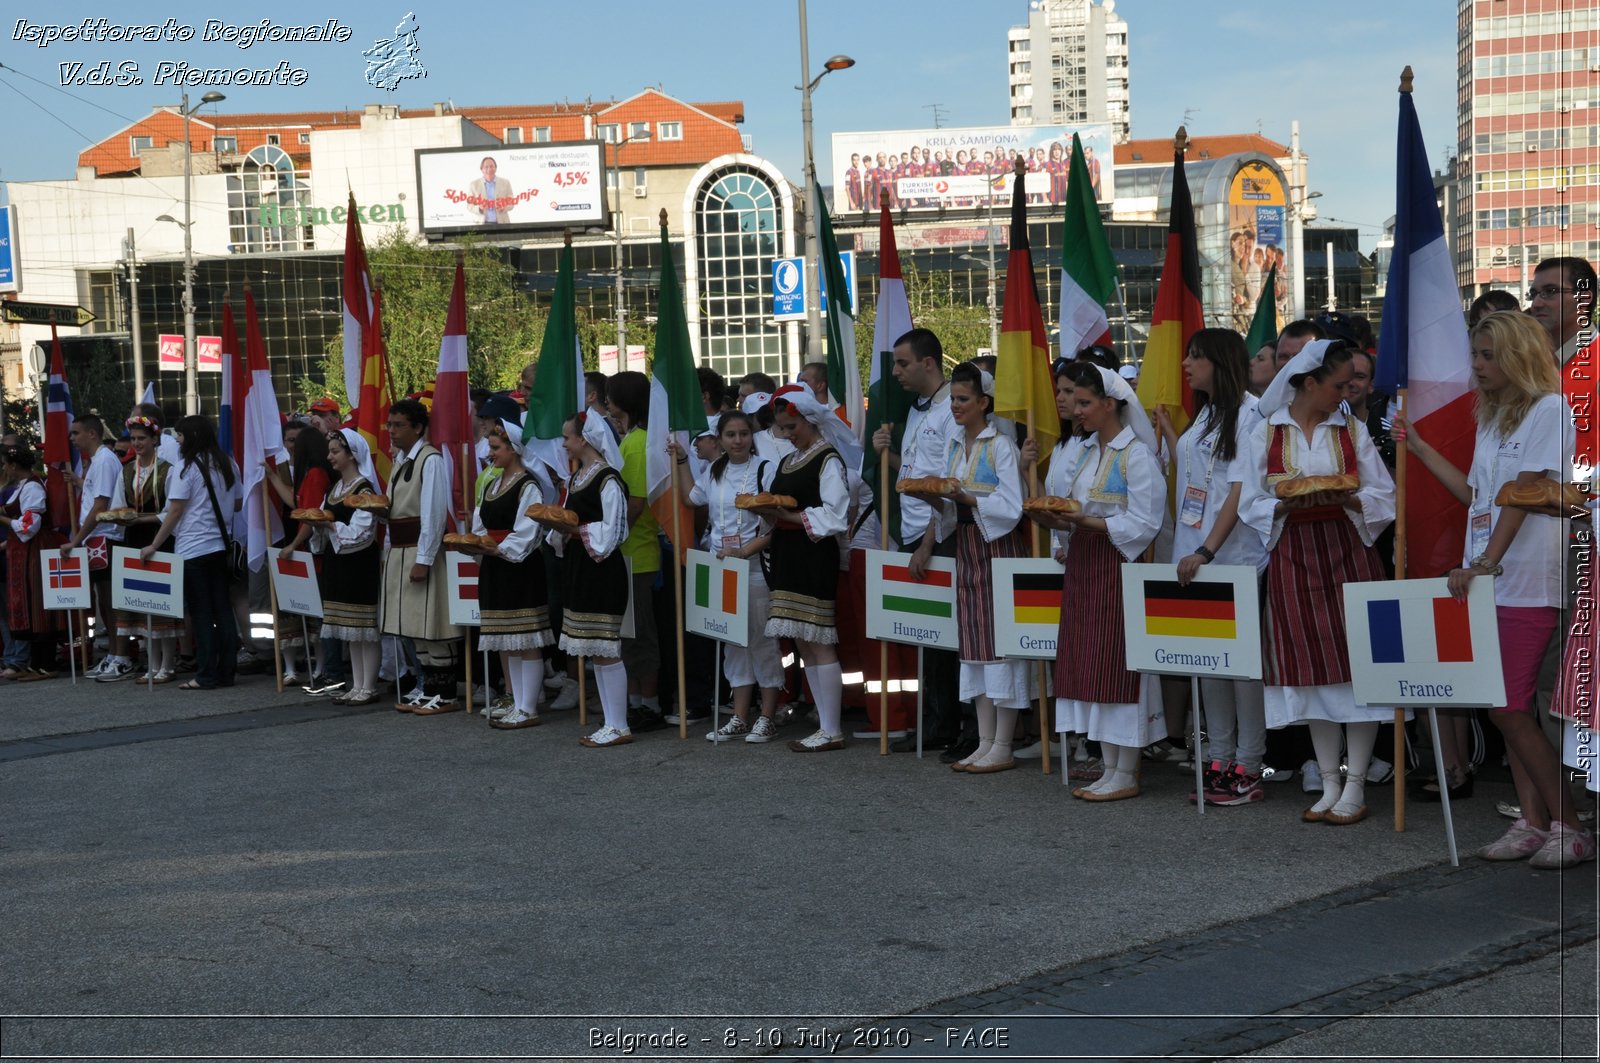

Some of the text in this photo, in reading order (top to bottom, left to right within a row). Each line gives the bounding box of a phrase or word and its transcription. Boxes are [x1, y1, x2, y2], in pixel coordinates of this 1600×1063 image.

[926, 134, 1019, 146] KRILA ŠAMPIONA
[57, 595, 76, 606] Norway
[124, 596, 171, 611] Netherlands
[704, 617, 728, 634] Ireland
[893, 622, 941, 642] Hungary
[1020, 635, 1057, 650] Germ
[1155, 648, 1230, 670] Germany I
[1398, 680, 1453, 697] France
